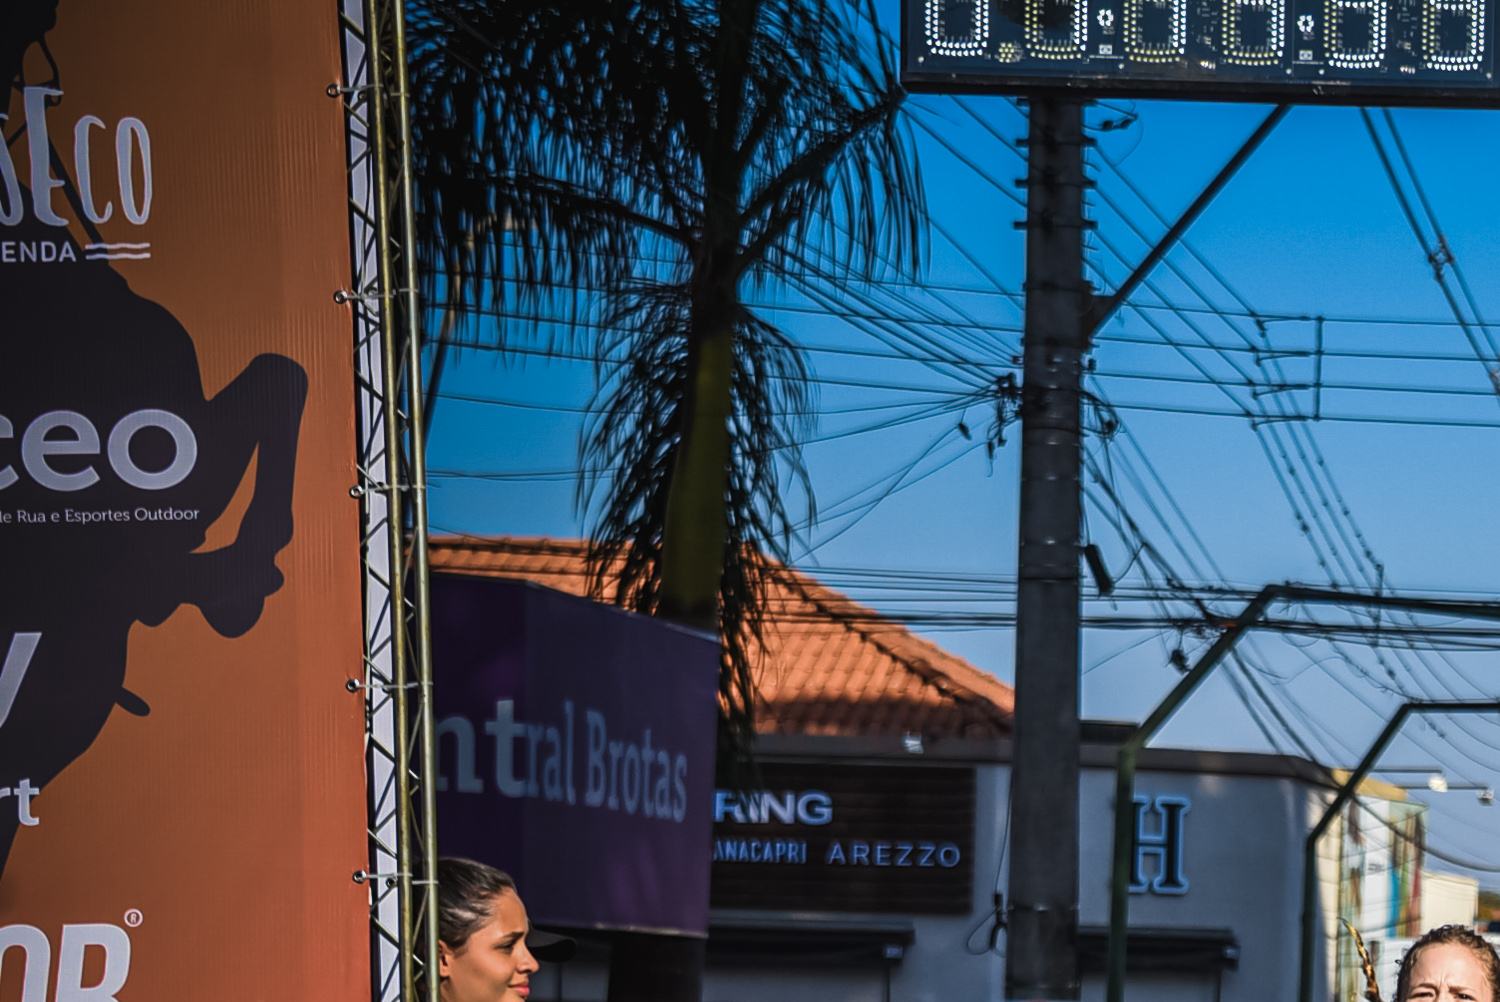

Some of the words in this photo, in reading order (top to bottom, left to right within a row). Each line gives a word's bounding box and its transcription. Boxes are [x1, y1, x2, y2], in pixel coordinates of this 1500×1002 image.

[1, 241, 77, 263] ENDA
[17, 509, 46, 523] Rua
[50, 511, 60, 522] e
[65, 508, 130, 525] Esportes
[134, 507, 200, 521] Outdoor
[585, 708, 688, 824] Brotas
[713, 838, 807, 864] ANACAPRI
[826, 841, 961, 868] AREZZO
[1129, 794, 1190, 895] H
